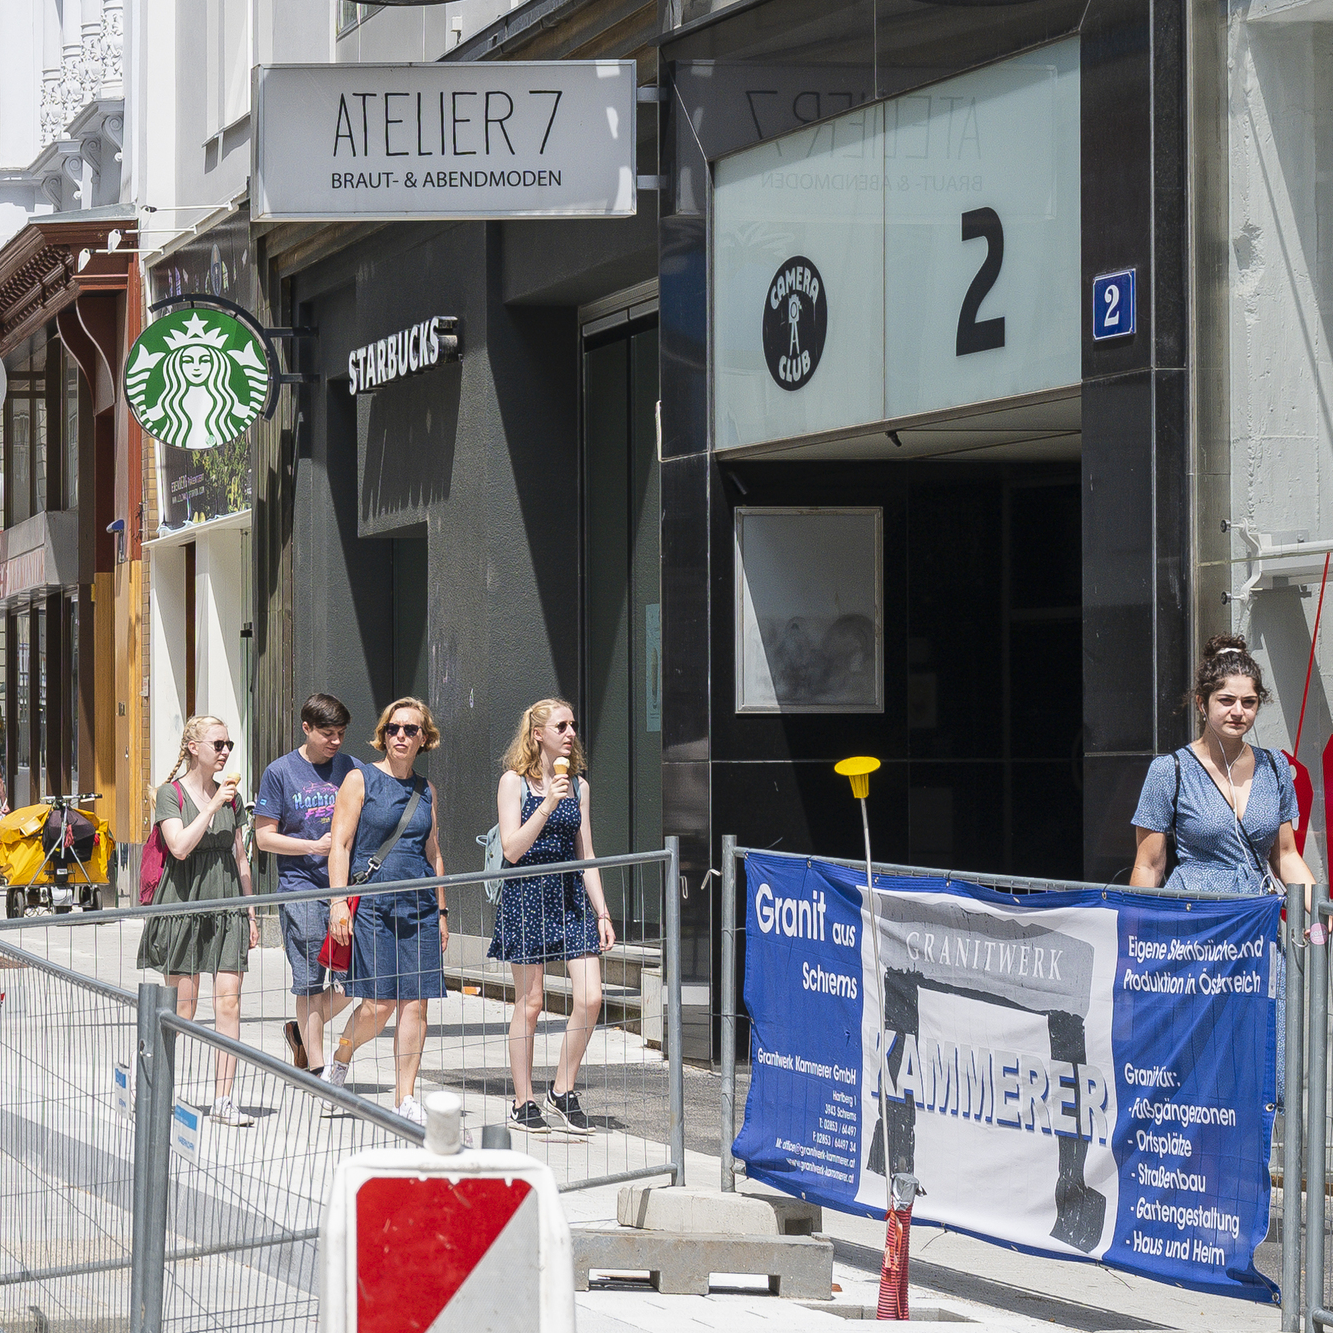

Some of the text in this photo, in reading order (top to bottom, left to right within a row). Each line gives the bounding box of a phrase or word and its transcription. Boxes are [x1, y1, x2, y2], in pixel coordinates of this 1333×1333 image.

[333, 90, 563, 157] ATELIER 7
[331, 170, 563, 189] BRAUT- & ABENDMODEN
[770, 266, 819, 310] CAMERA
[955, 206, 1005, 356] 2
[1103, 284, 1120, 327] 2
[348, 316, 441, 396] STARBUCKS
[778, 350, 811, 383] CLUB
[755, 882, 856, 948] Granit aus
[906, 930, 1064, 981] GRANITWERK
[1128, 934, 1167, 964] Eigene
[802, 961, 858, 1000] Schrems
[1123, 967, 1184, 995] Produktion
[1184, 972, 1196, 995] in
[757, 1047, 857, 1086] Granitwerk Kammerer GmbH
[868, 1026, 1110, 1146] KAMMERER
[837, 1105, 858, 1122] Schrems
[1136, 1129, 1193, 1158] Ortsplätze
[1137, 1162, 1207, 1193] Straßenbau
[1135, 1196, 1241, 1240] Gartengestaltung
[1132, 1229, 1226, 1267] Haus und Heim
